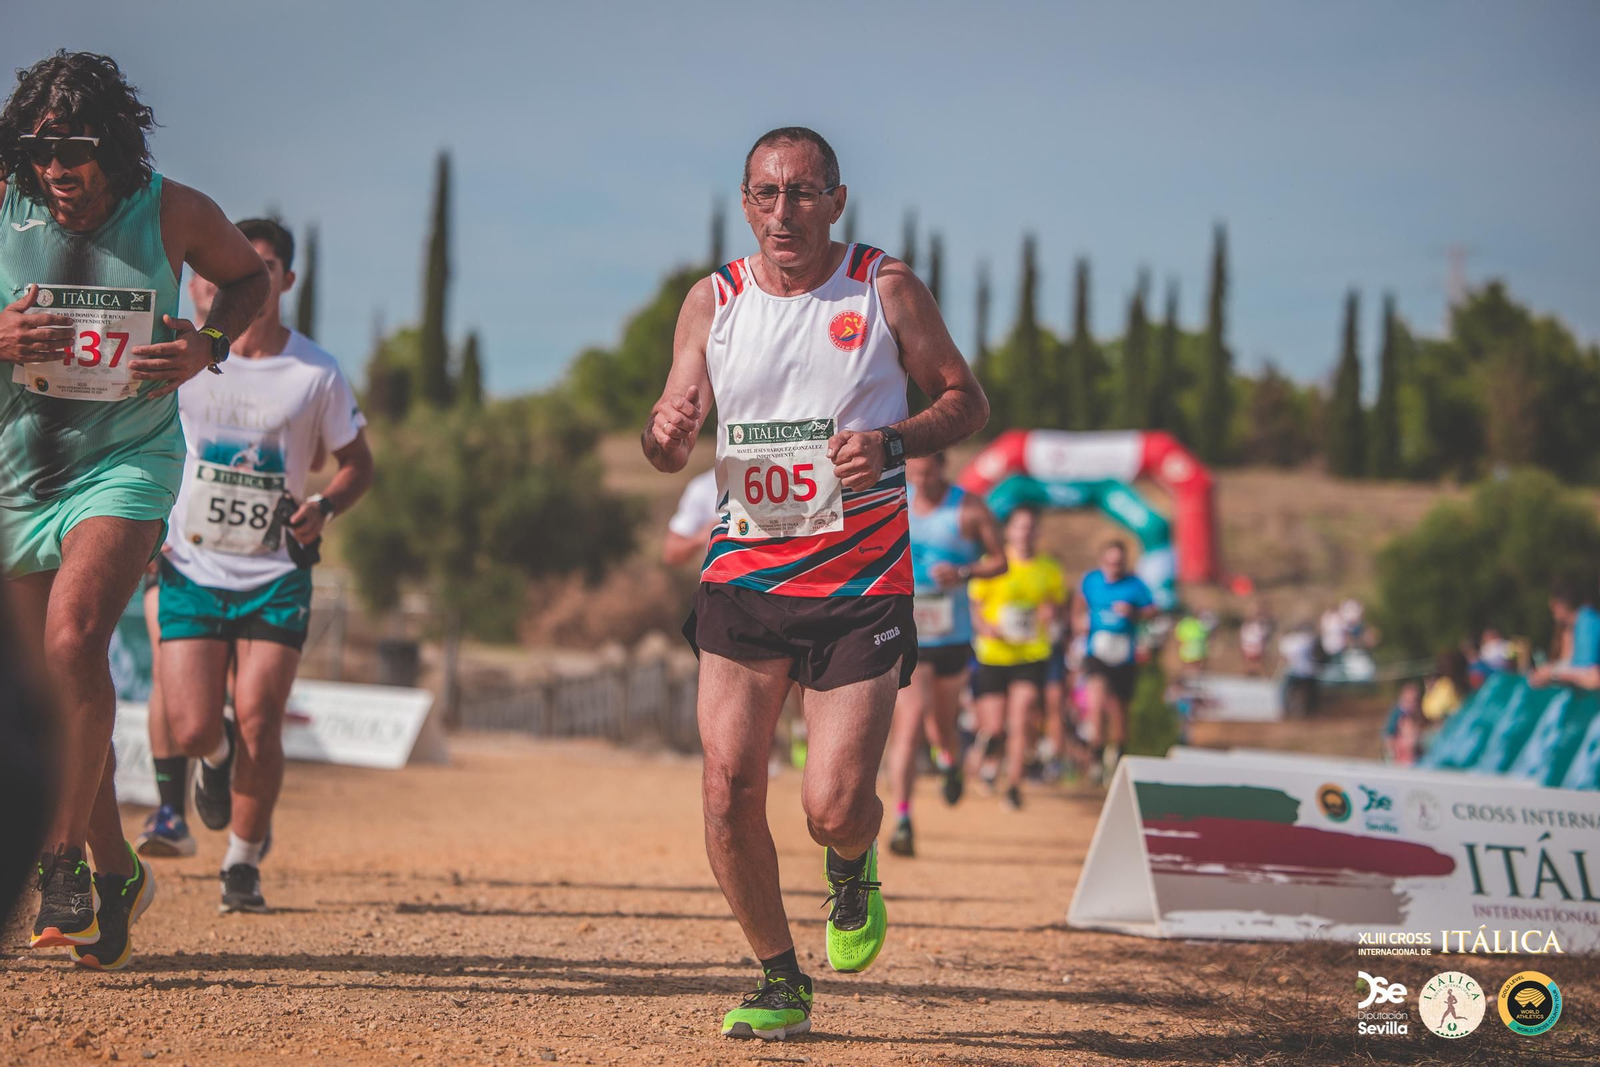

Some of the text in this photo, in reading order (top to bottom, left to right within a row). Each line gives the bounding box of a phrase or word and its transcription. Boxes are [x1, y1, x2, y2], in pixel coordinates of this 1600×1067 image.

[62, 290, 121, 307] ITÁLICA
[748, 424, 803, 440] ITÁLICA
[744, 463, 818, 505] 605
[207, 497, 269, 530] 558
[1452, 803, 1517, 824] CROSS
